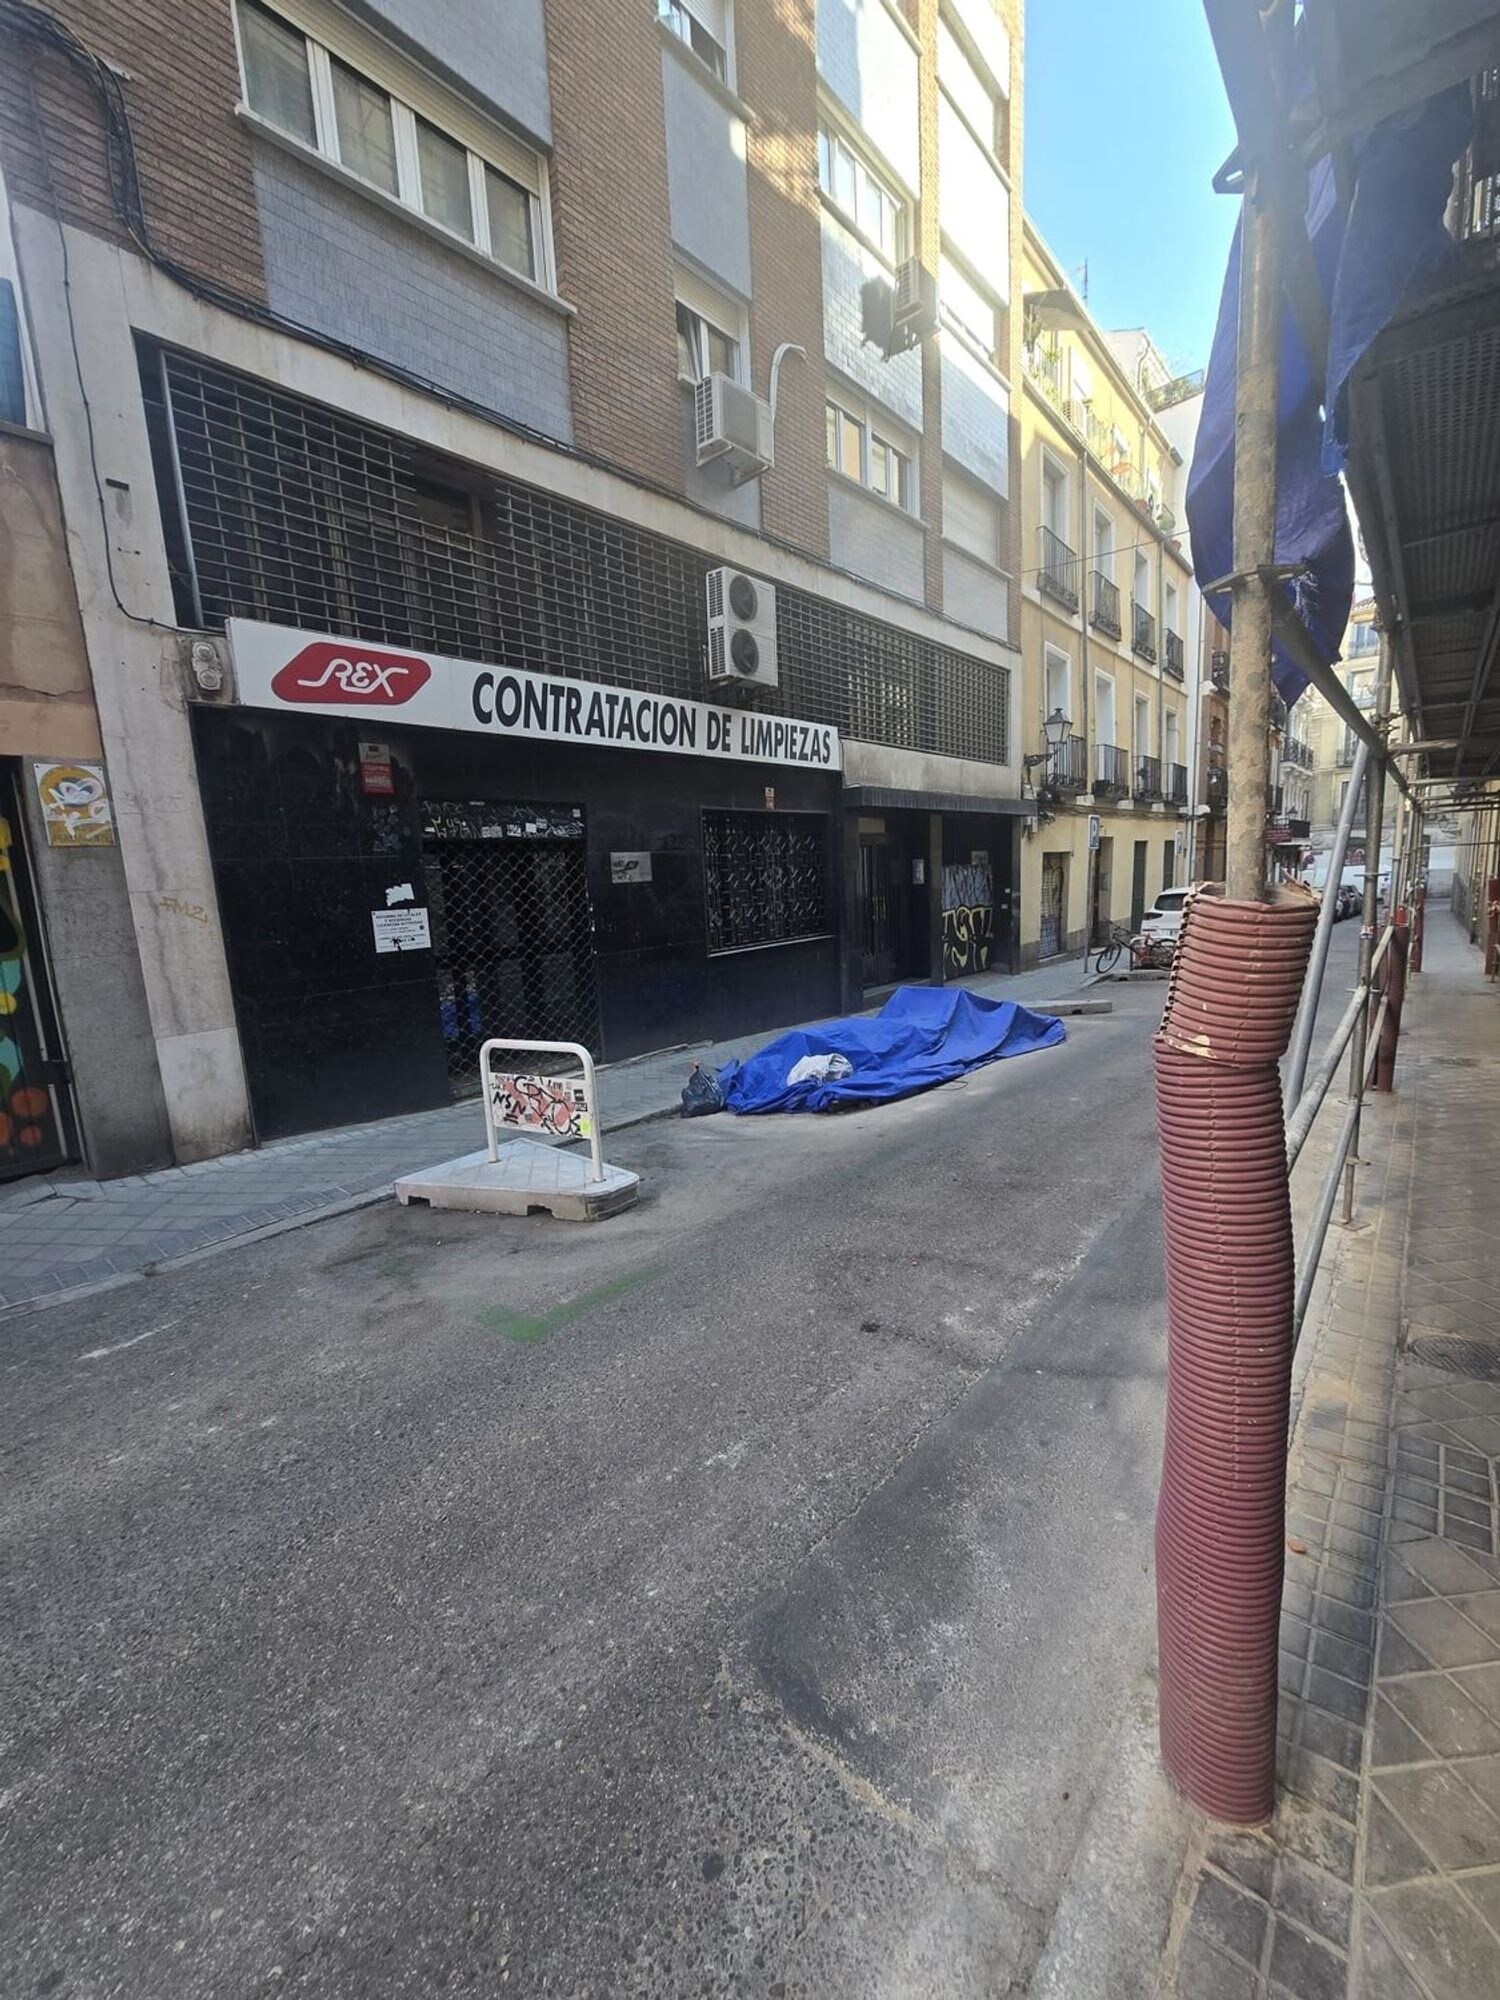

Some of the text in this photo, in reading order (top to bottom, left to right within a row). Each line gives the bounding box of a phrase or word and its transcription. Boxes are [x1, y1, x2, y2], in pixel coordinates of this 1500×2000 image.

[297, 657, 409, 698] REX
[472, 672, 831, 764] CONTRATACION DE LIMPIEZAS
